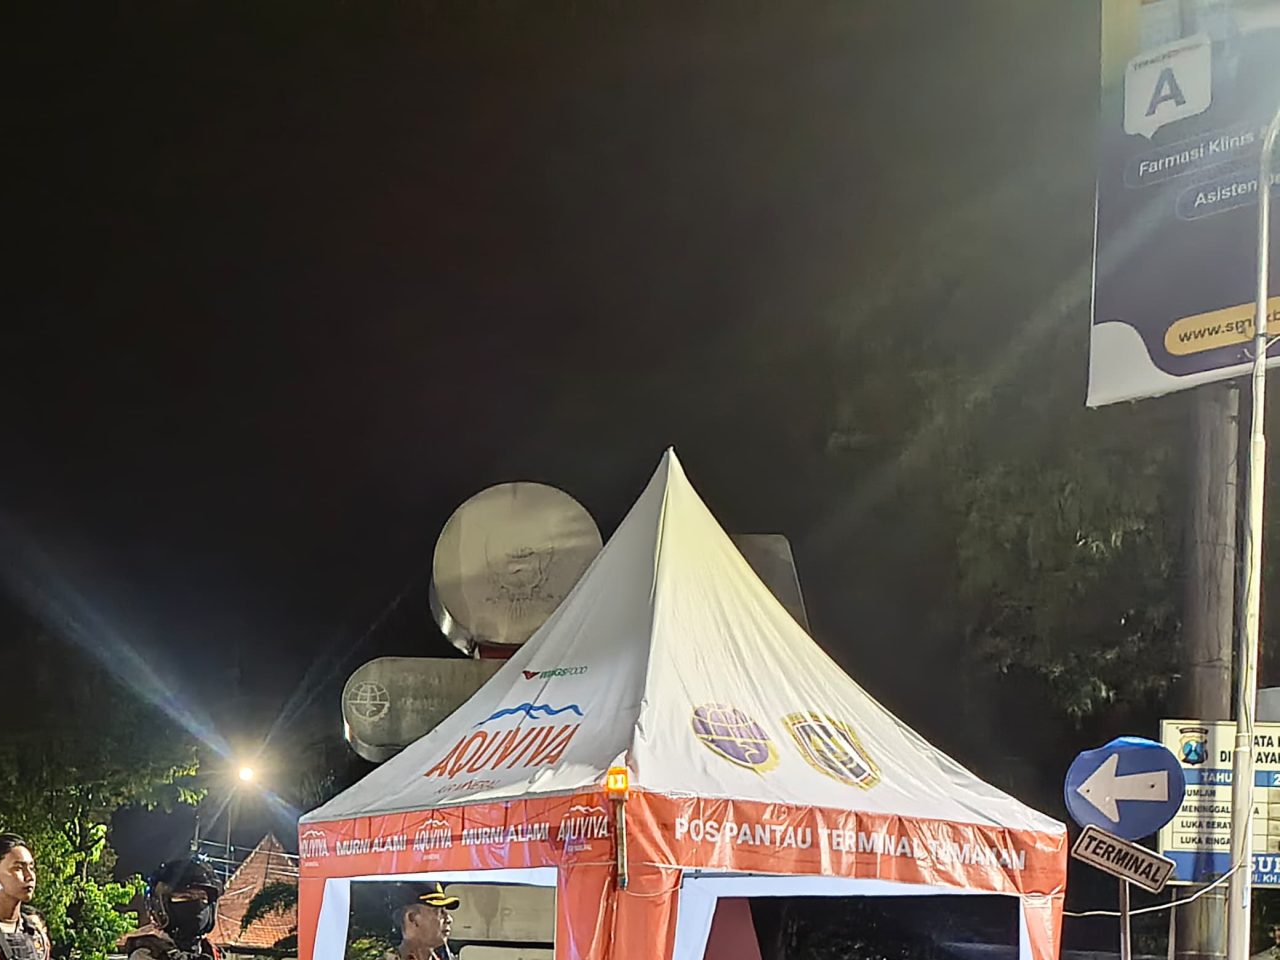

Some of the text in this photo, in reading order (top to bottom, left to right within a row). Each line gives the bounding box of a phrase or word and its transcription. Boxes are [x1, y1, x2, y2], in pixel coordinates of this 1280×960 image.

[1144, 67, 1187, 117] A
[1139, 143, 1205, 177] Farmasi
[1194, 179, 1257, 209] Asisten
[1201, 771, 1233, 783] TAHU
[1185, 789, 1216, 798] UMLAH
[461, 822, 550, 846] MURNI ALAMI
[675, 817, 720, 843] POS
[723, 821, 812, 850] PANTAU
[1181, 820, 1204, 829] LUKA
[1180, 836, 1203, 845] LUKA
[1084, 834, 1161, 883] TERMINAL
